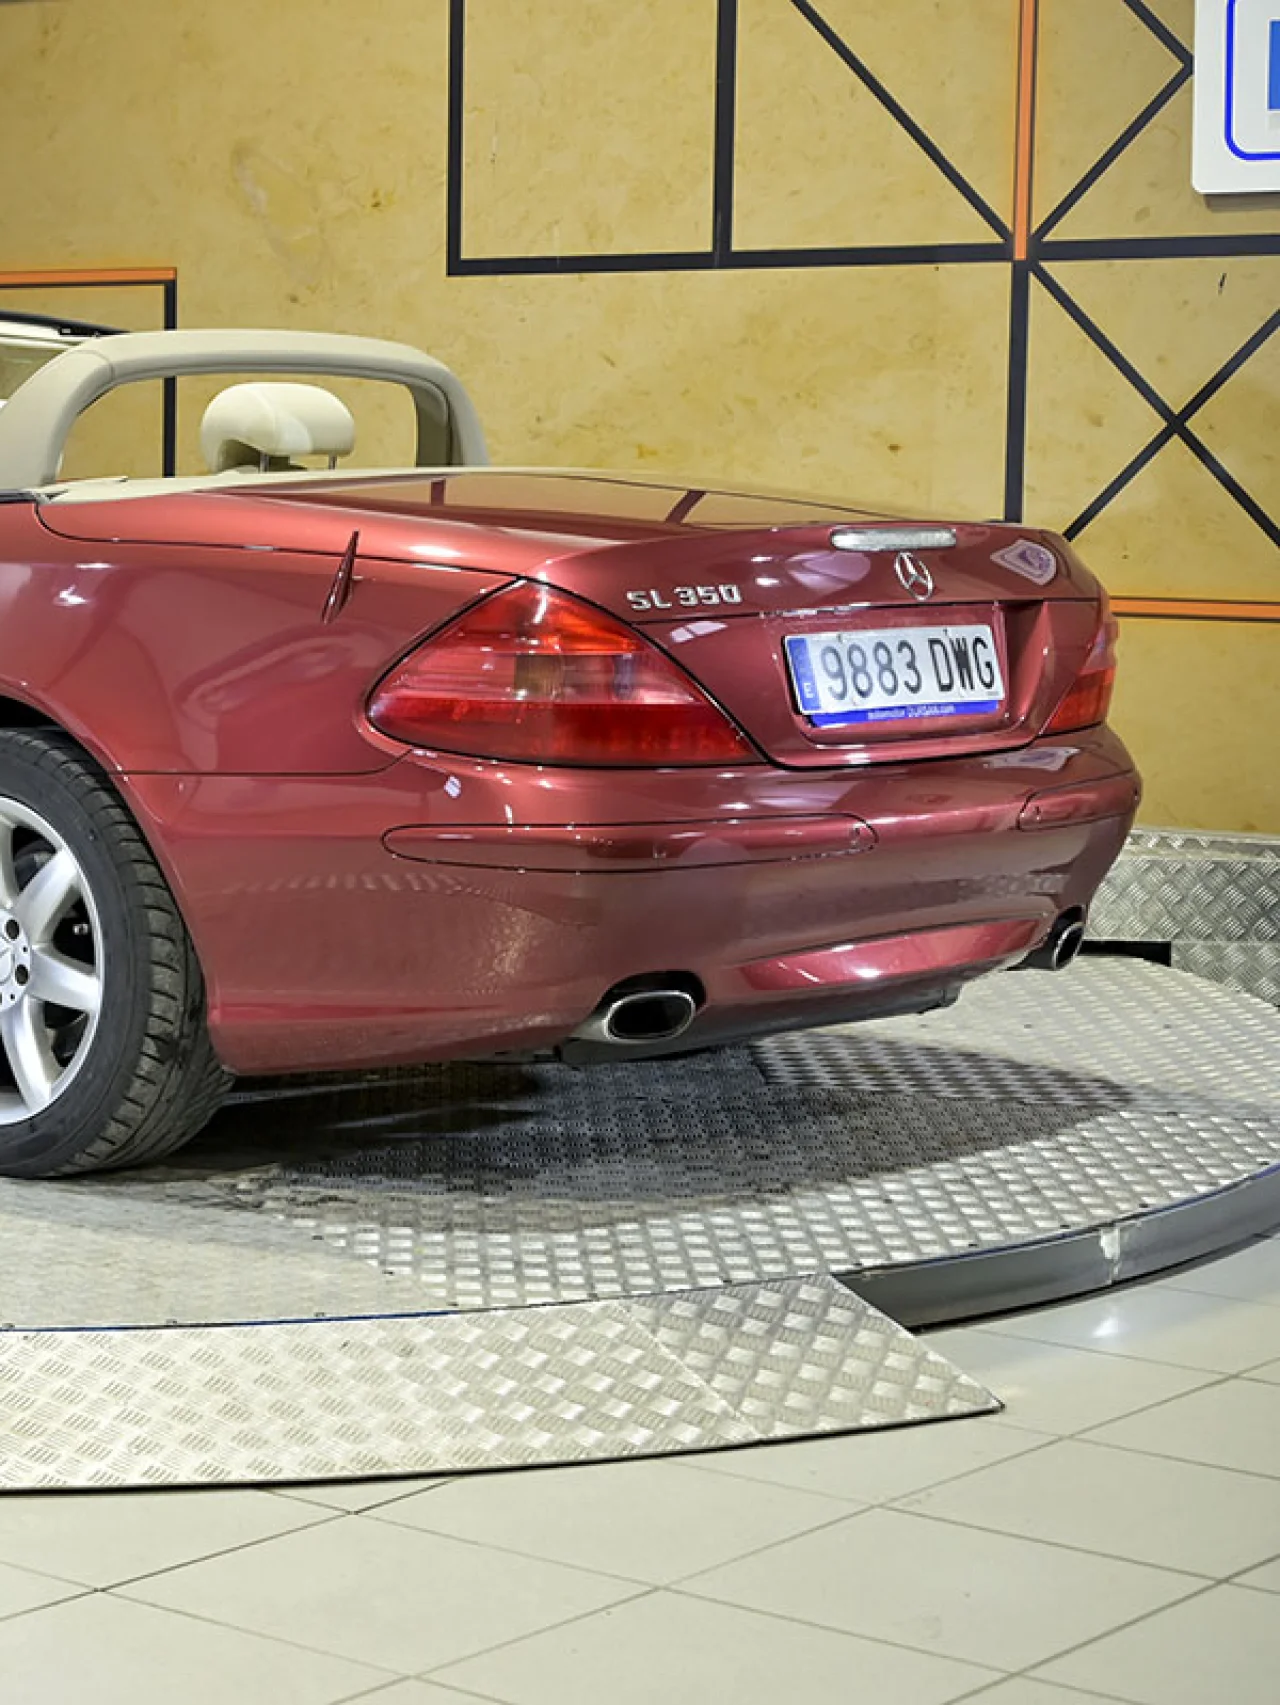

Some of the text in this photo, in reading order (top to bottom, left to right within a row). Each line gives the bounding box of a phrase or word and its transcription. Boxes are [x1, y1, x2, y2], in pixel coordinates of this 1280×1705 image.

[626, 584, 742, 611] SL 350
[820, 636, 995, 700] 9883 DWG
[803, 682, 815, 698] E
